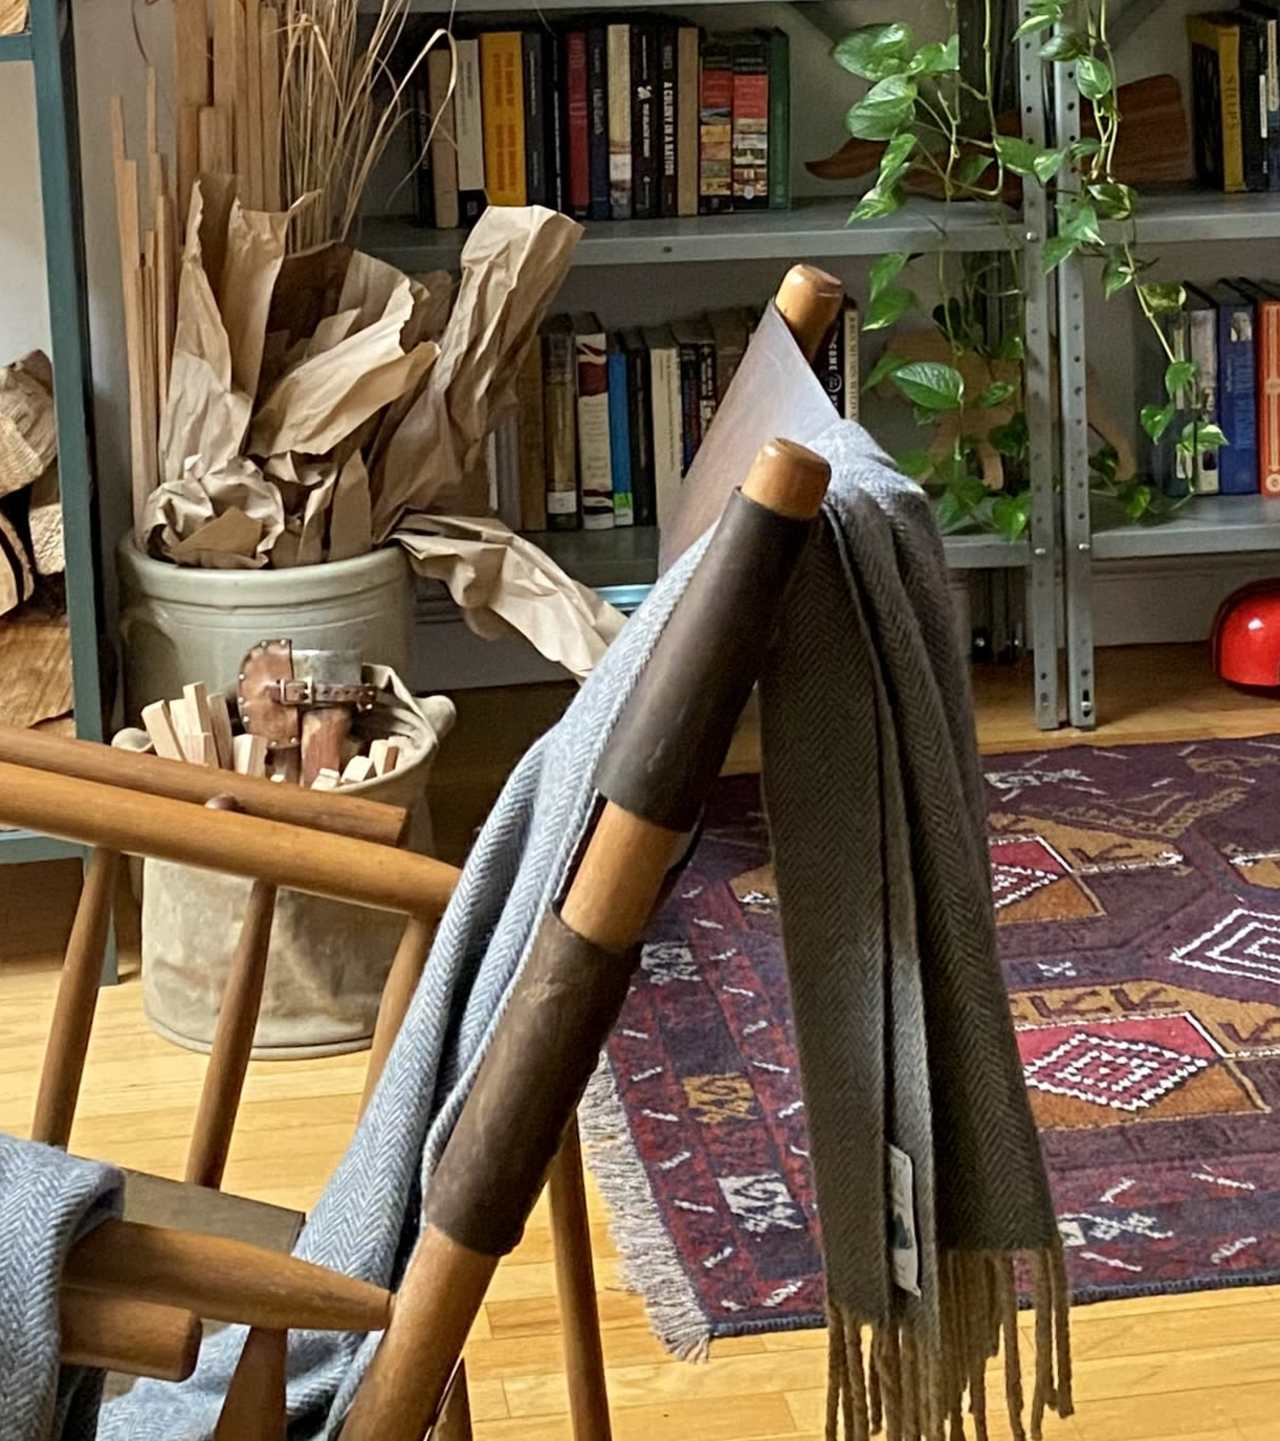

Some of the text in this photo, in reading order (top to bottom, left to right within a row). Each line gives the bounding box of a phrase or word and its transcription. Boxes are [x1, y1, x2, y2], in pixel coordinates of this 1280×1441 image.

[664, 89, 674, 123] COLONY
[664, 124, 674, 135] IN
[664, 135, 674, 143] A
[664, 144, 674, 177] NATION
